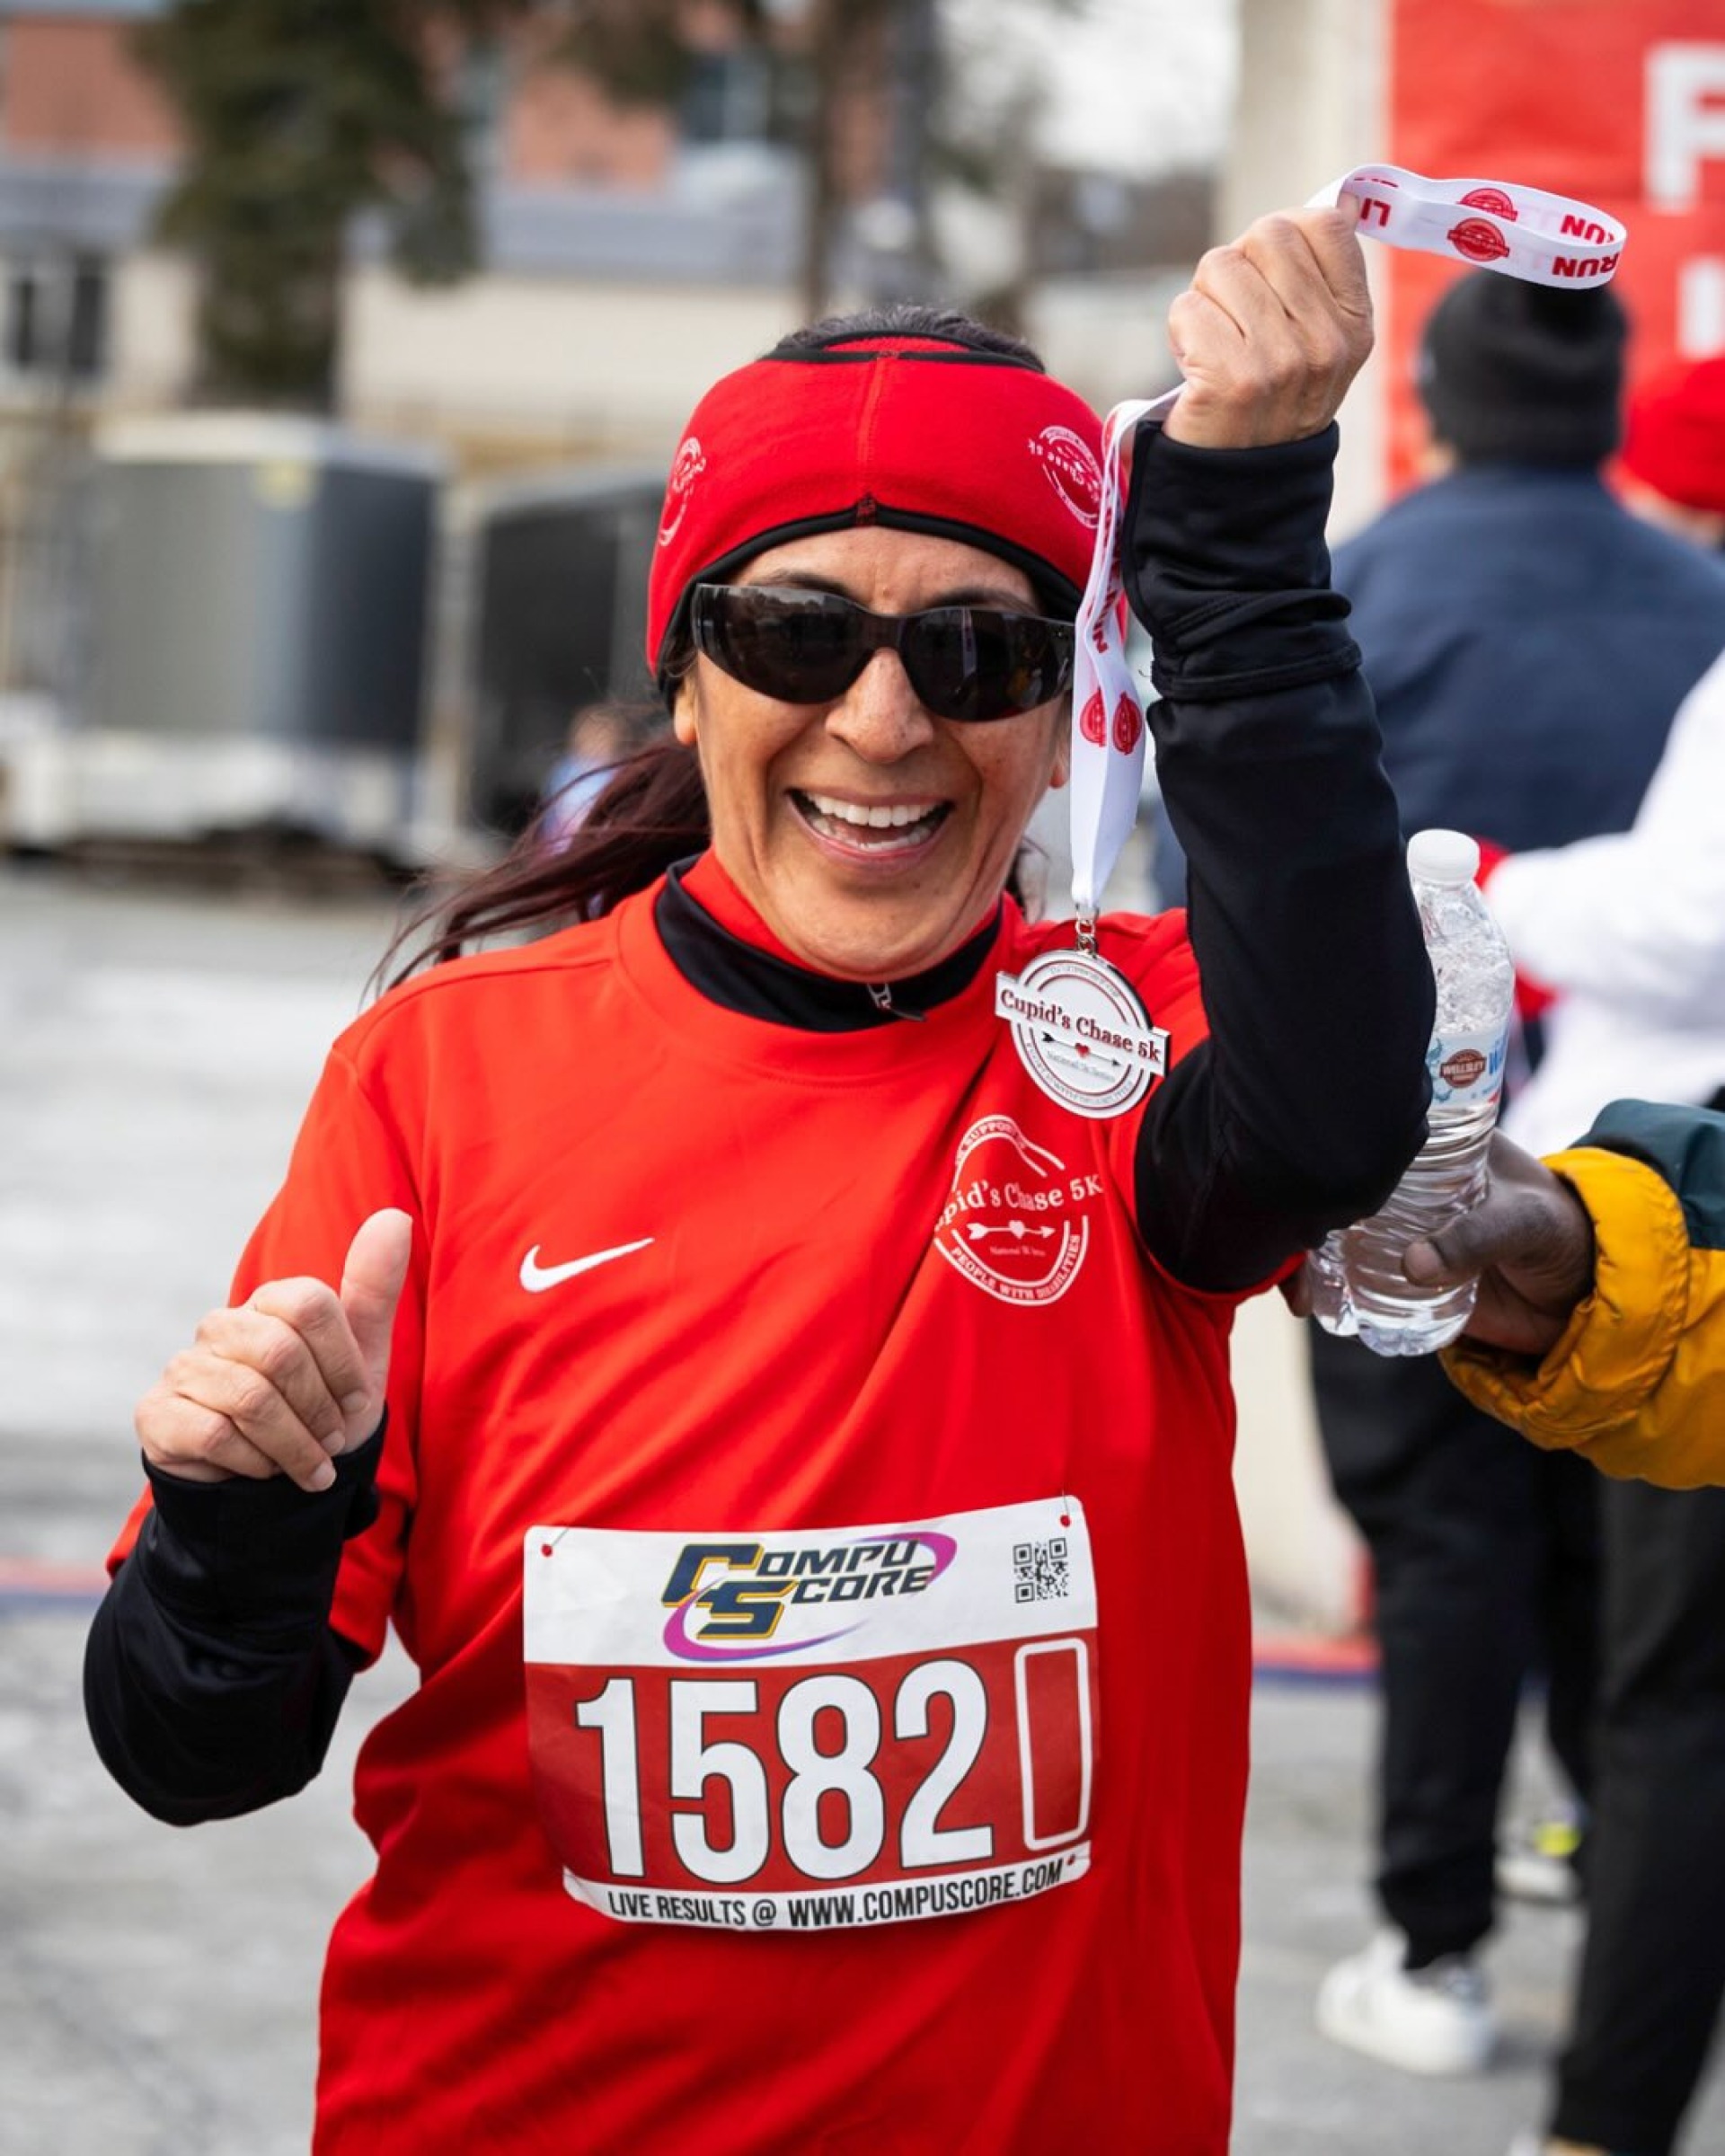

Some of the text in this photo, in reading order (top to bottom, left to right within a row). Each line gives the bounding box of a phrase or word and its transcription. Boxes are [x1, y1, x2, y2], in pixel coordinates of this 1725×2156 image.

[1000, 988, 1071, 1029] Cupid's
[1075, 1016, 1134, 1053] Chase
[1069, 1173, 1104, 1202] 5K
[951, 1247, 996, 1289] PEOPLE
[575, 1658, 995, 1885] 1582
[607, 1857, 1064, 1927] LIVE RESULTS @ WWW.COMPUSCORE.COM
